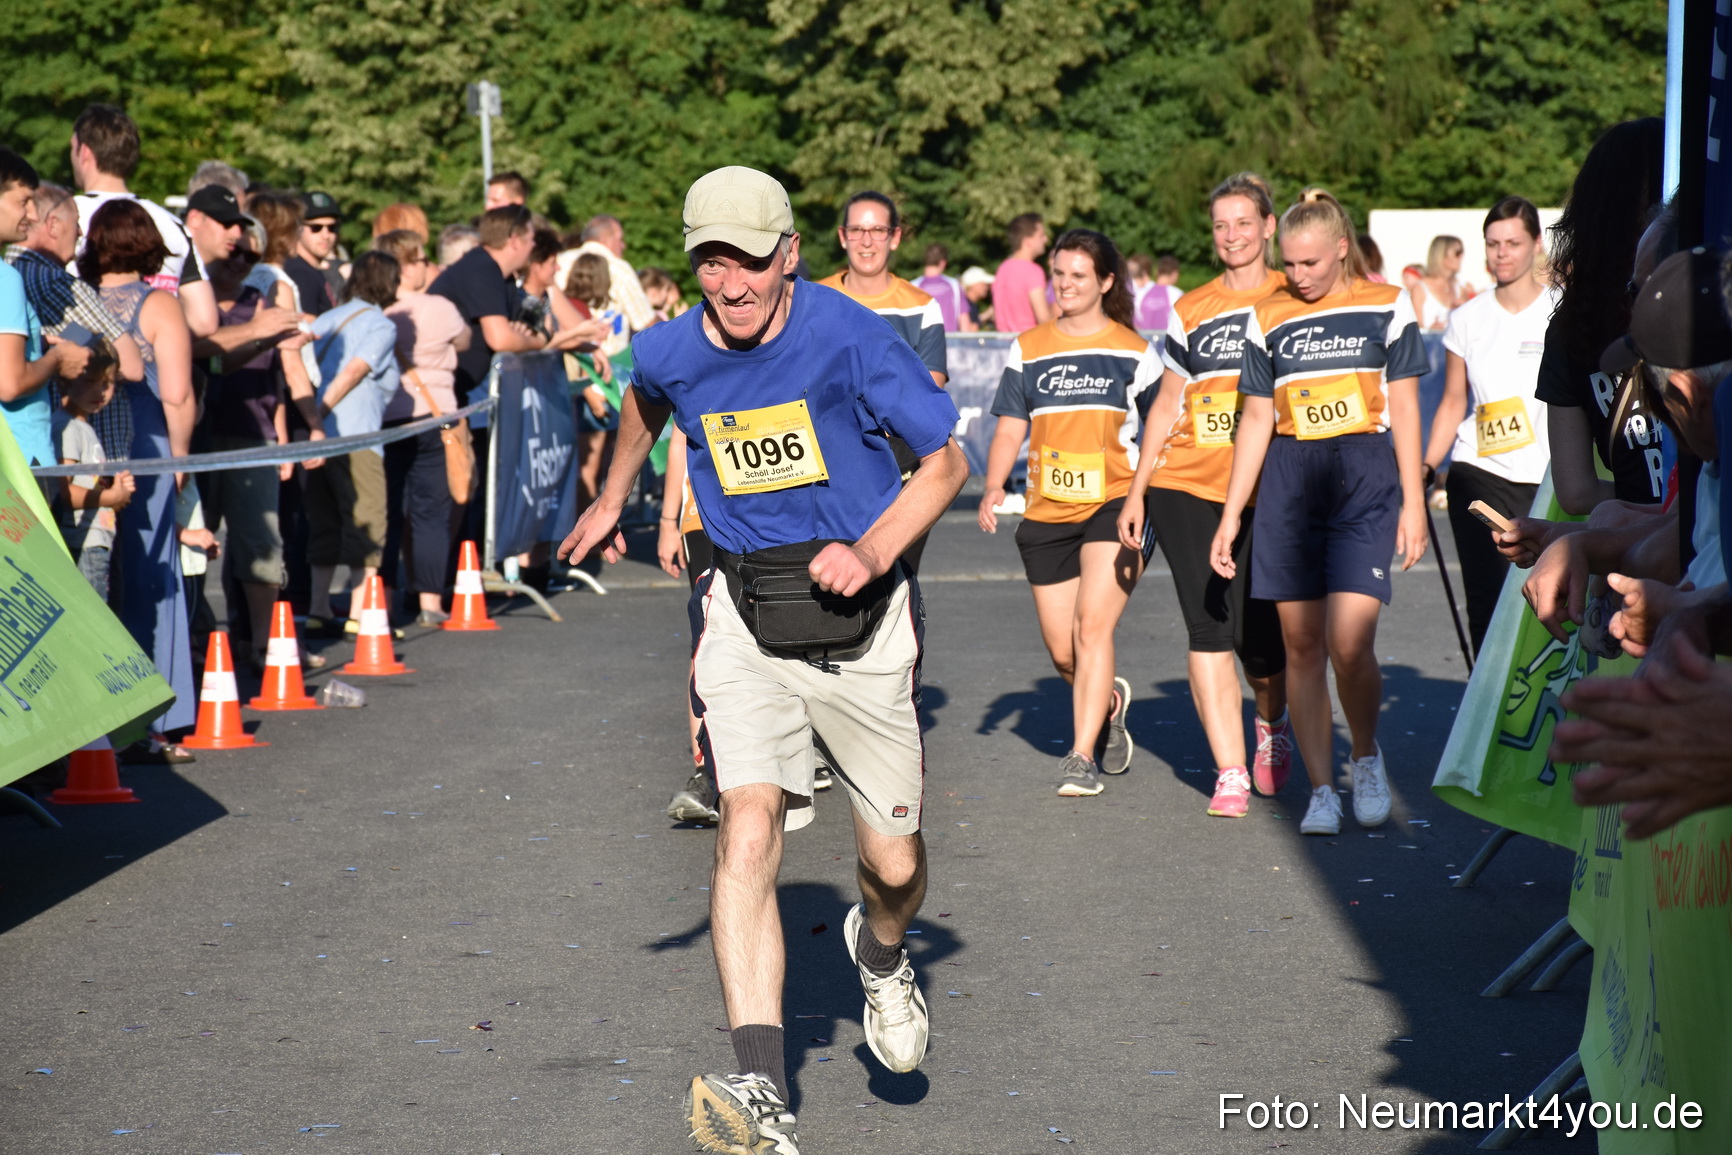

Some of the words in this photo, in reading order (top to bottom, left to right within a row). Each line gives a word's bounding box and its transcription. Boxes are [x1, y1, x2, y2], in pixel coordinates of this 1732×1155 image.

[1210, 337, 1246, 353] Fisc
[1292, 334, 1368, 354] Fischer
[1216, 351, 1243, 360] AUTO
[1299, 348, 1362, 361] AUTOMOBILE
[1049, 373, 1114, 390] Fischer
[1054, 388, 1108, 397] AUTOMOBILE
[1306, 400, 1348, 424] 600
[1480, 415, 1521, 440] 1414
[725, 433, 805, 470] 1096
[744, 467, 769, 479] Schöll
[771, 464, 794, 476] Josef
[767, 473, 795, 483] Neumarkt
[1052, 467, 1085, 488] 601
[19, 648, 58, 699] neumarkt
